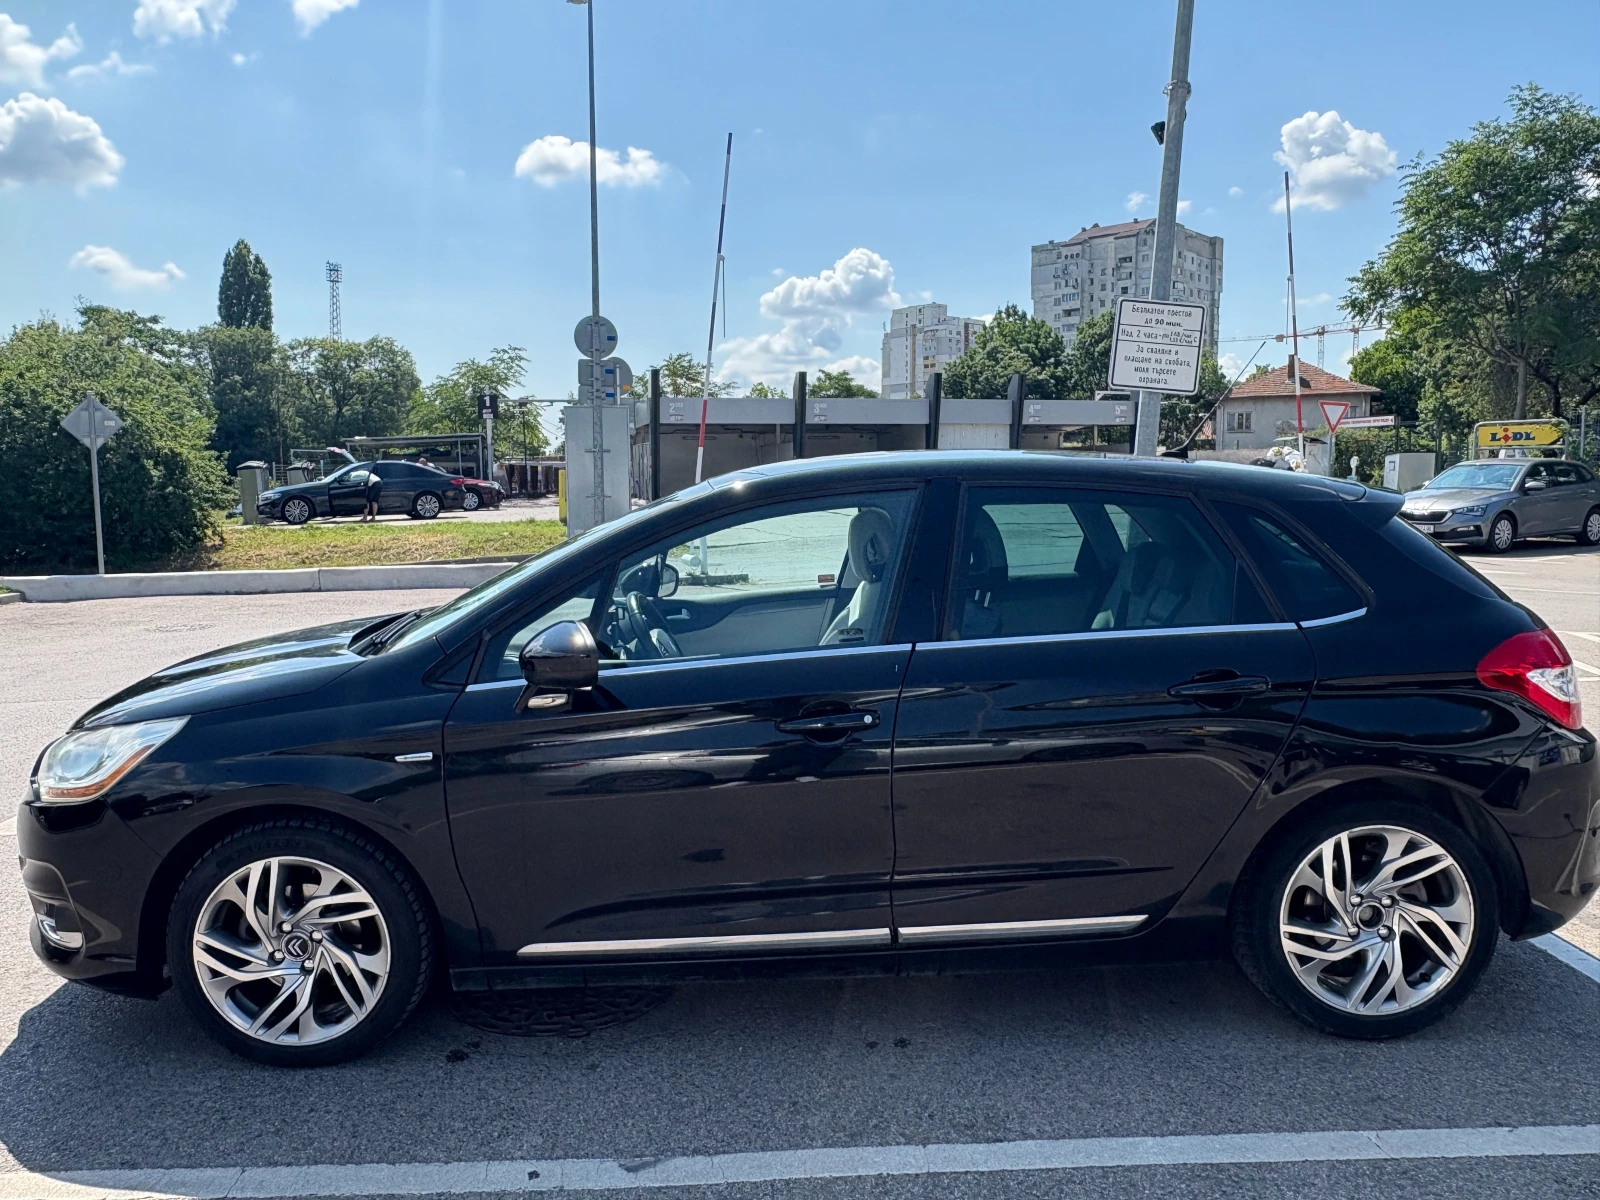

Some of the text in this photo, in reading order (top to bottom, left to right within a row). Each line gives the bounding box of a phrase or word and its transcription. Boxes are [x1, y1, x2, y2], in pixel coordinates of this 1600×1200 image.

[1121, 328, 1134, 338] Над
[1136, 329, 1141, 338] 2
[1135, 344, 1144, 353] За
[1154, 357, 1162, 365] на
[669, 402, 676, 413] 2
[813, 402, 820, 414] 3
[1028, 404, 1034, 415] 4
[1115, 404, 1121, 415] 5
[1489, 427, 1536, 444] LIDL
